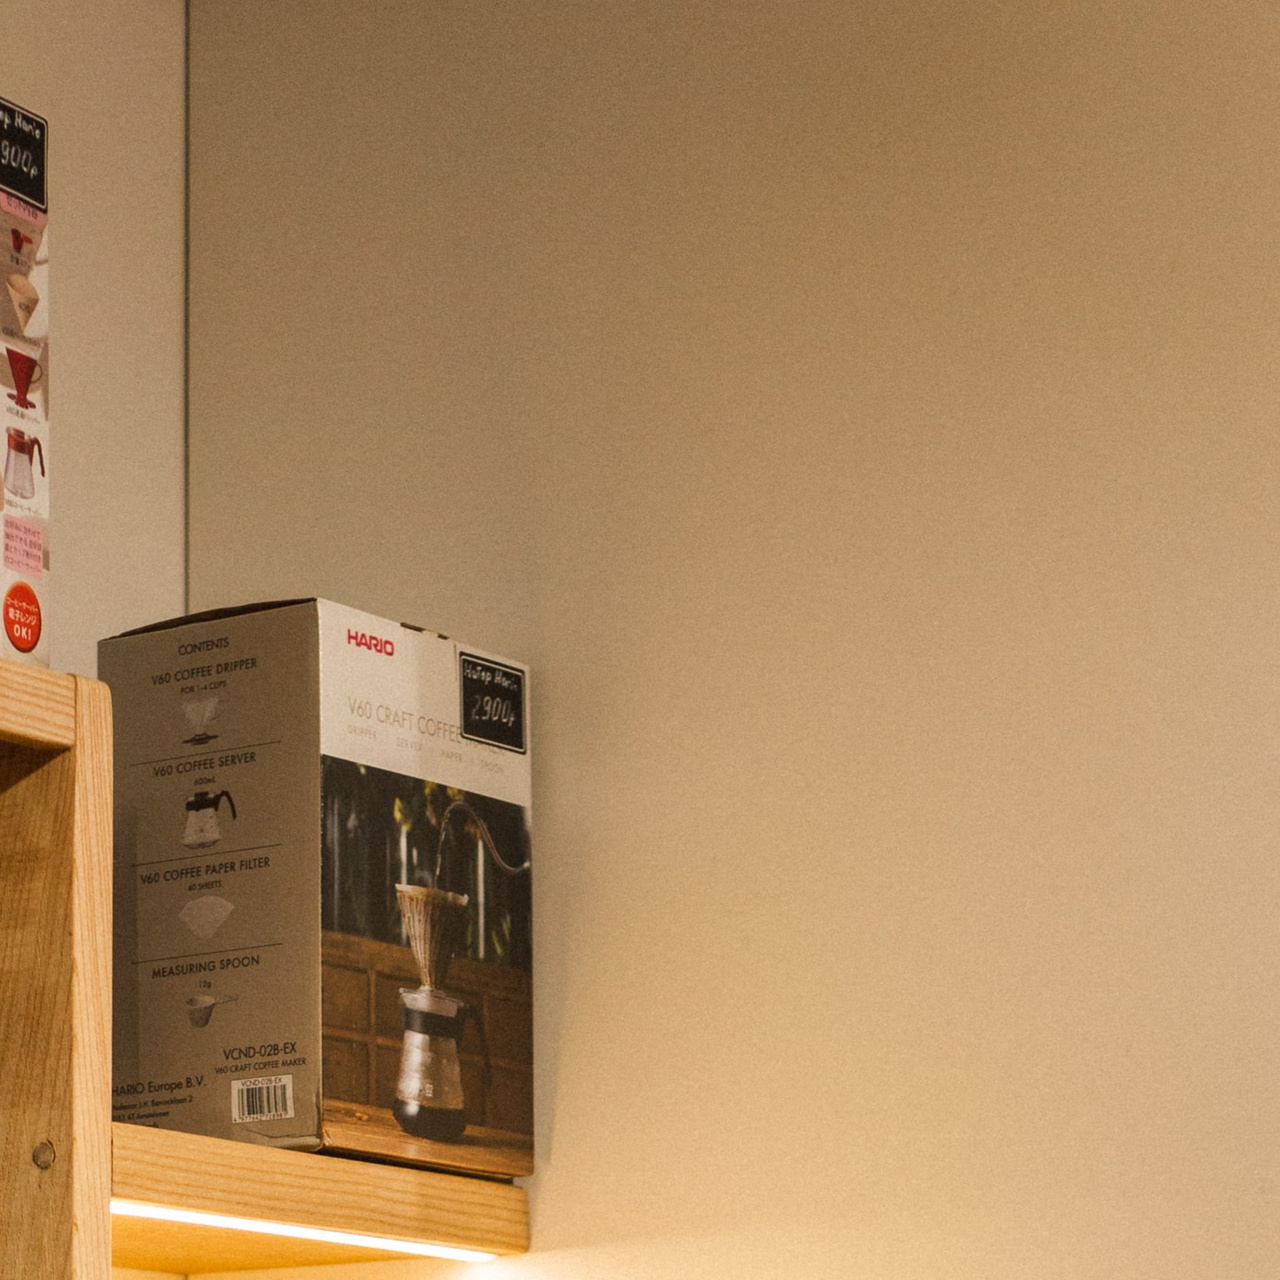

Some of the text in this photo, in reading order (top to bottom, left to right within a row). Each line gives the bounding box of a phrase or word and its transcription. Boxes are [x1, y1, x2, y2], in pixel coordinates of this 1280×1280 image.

[13, 624, 32, 641] OK!
[347, 629, 395, 657] HARIO
[178, 637, 230, 656] CONTENTS
[151, 657, 258, 686] V60 COFFEE DRIPPER
[180, 685, 195, 695] FOR
[348, 696, 463, 745] V60 CRAFT COFFEE
[153, 751, 256, 777] V60 COFFEE SERVER
[140, 856, 271, 885] V60 COFFEE PAPER FILTER
[152, 955, 260, 980] MEASURING SPOON
[223, 1041, 297, 1061] VCND-02B-EX
[214, 1057, 307, 1076] V60 CRAFT COFFEE MAKER
[148, 1080, 183, 1093] Europe
[186, 1075, 207, 1089] B.V.
